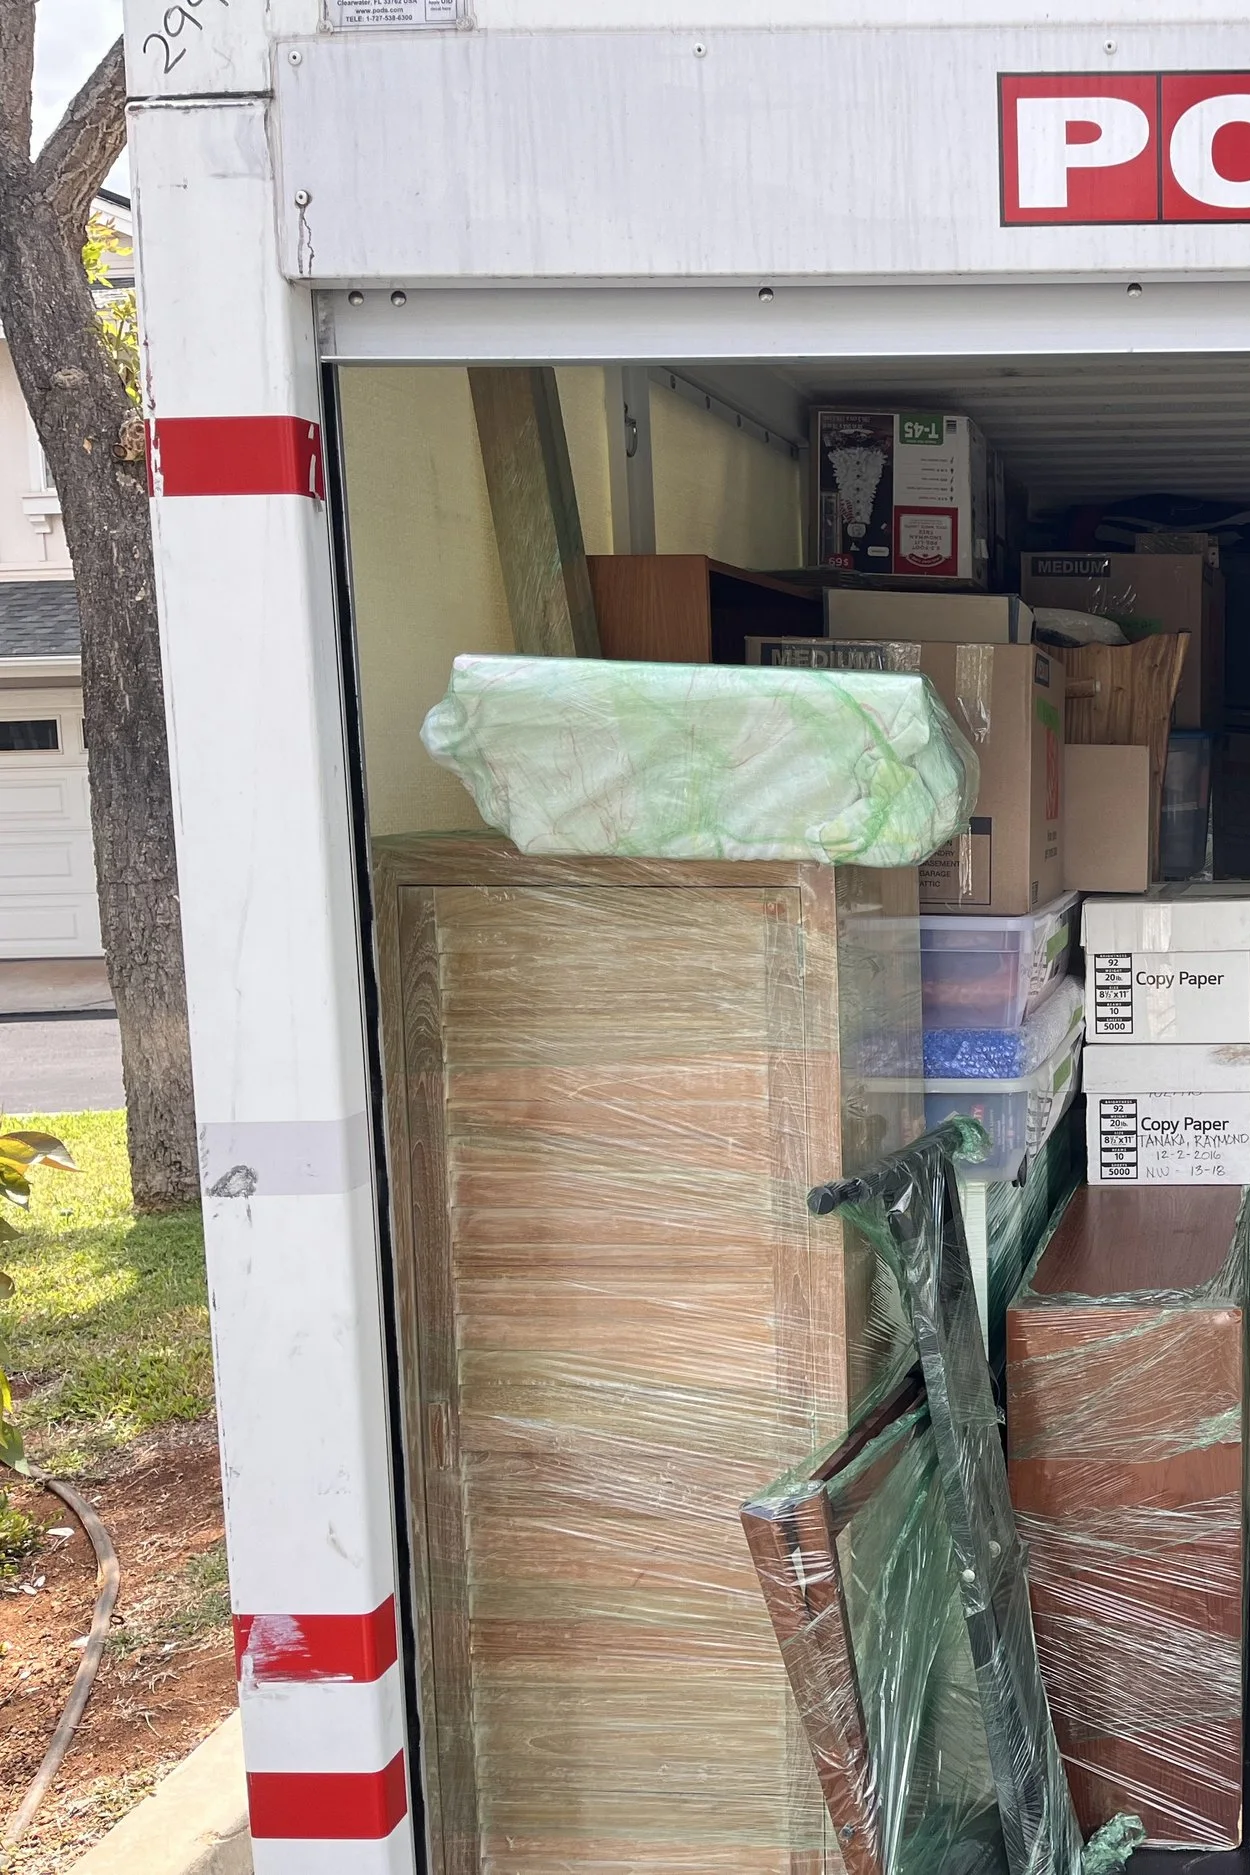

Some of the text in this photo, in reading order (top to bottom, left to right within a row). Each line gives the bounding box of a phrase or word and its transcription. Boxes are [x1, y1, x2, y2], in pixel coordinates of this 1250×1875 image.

[143, 0, 229, 74] 29
[904, 422, 939, 439] T-45
[1038, 559, 1106, 574] MEDIUM
[771, 649, 877, 669] MEDIUM
[1108, 959, 1119, 967] 92
[1136, 970, 1225, 989] Copy Paper
[1110, 1007, 1119, 1015] 10
[1103, 1022, 1126, 1031] 5000
[1141, 1117, 1230, 1134] Copy Paper
[1137, 1133, 1249, 1149] TANAKA, RAYMOND
[1108, 1168, 1130, 1176] 5000
